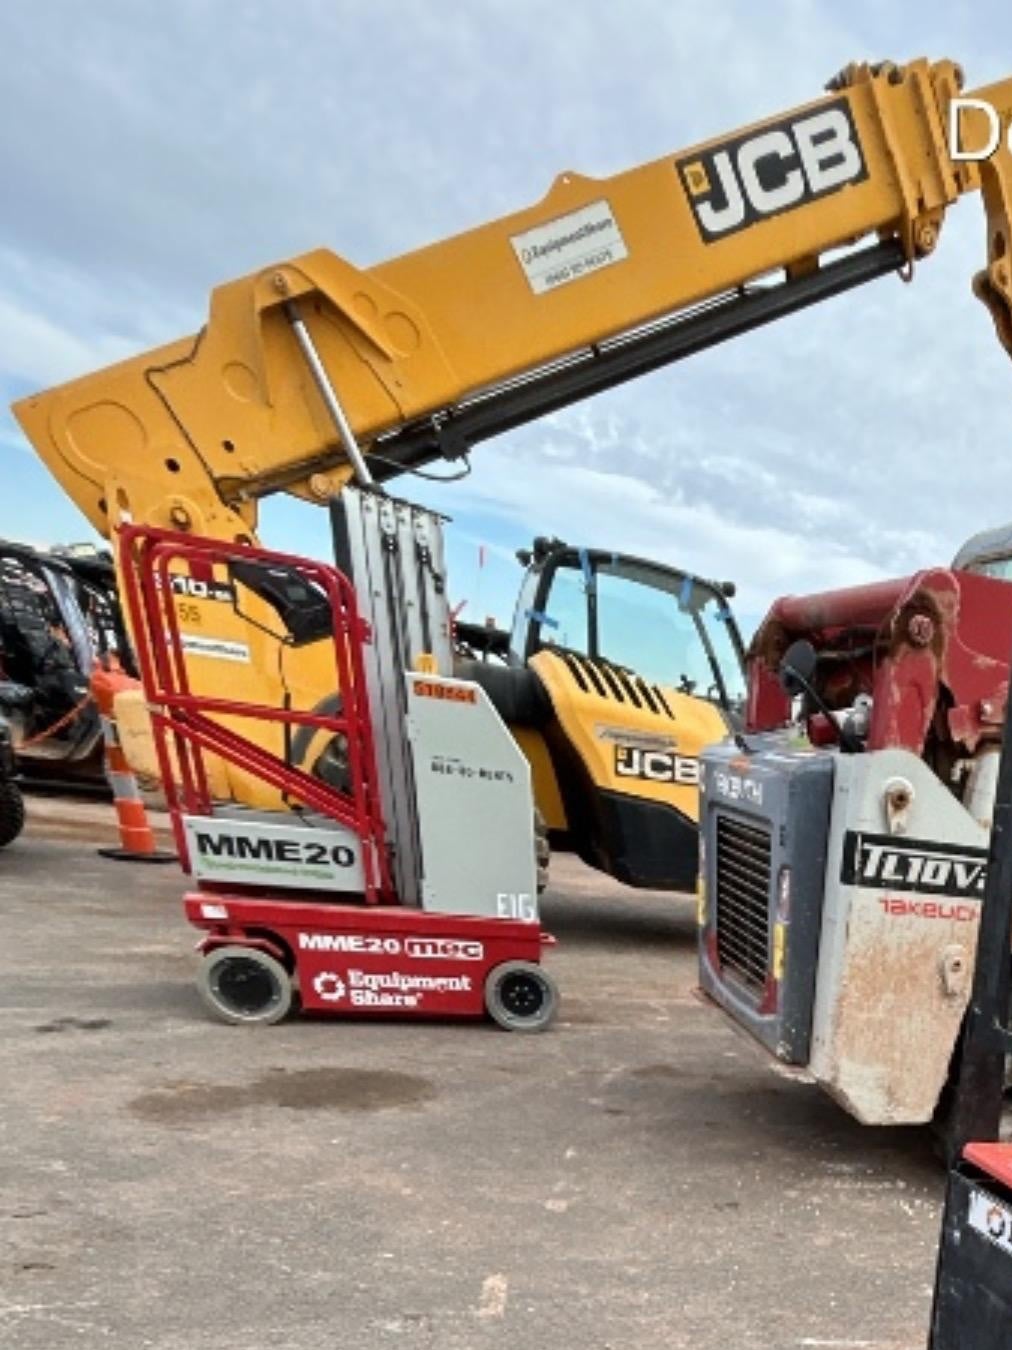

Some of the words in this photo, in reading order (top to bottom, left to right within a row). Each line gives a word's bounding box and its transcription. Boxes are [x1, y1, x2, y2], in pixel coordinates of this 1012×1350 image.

[695, 108, 863, 233] JCB
[616, 748, 700, 785] JCB
[197, 833, 355, 868] MME20
[298, 932, 401, 955] MME20
[347, 967, 472, 992] Equipment
[350, 988, 421, 1007] Share
